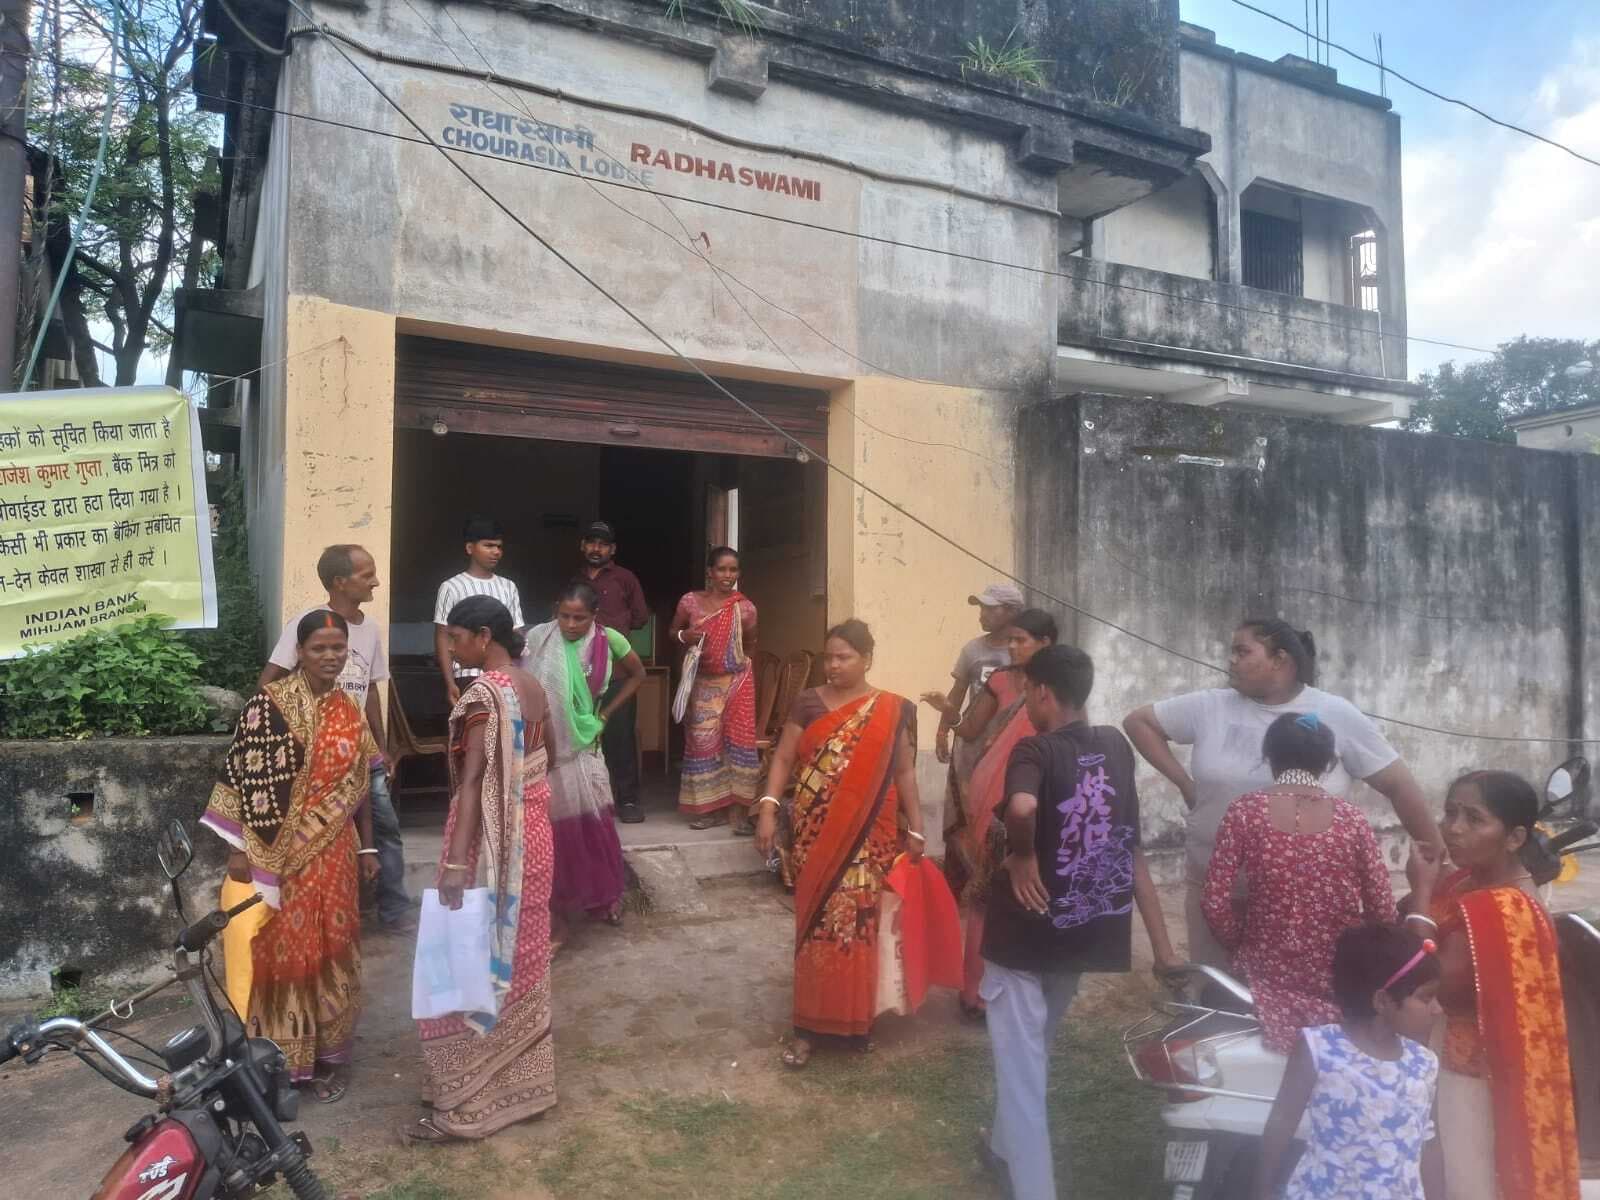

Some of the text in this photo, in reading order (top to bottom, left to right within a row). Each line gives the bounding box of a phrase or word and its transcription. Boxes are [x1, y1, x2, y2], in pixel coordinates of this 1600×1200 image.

[442, 126, 571, 169] CHOURASIA
[630, 142, 821, 201] RADHASWAMI
[27, 424, 46, 448] को
[50, 423, 87, 452] सूचित
[93, 420, 123, 442] किया
[128, 422, 157, 440] जाता
[161, 415, 170, 439] है
[35, 463, 70, 489] कुमार
[112, 452, 132, 475] बैंक
[137, 451, 159, 472] मित्र
[0, 494, 47, 522] ोवाईडर
[51, 497, 78, 517] द्वारा
[82, 494, 104, 514] हटा
[108, 487, 134, 510] दिया
[139, 488, 159, 505] गया
[33, 530, 48, 552] भी
[53, 531, 87, 550] प्रकार
[37, 564, 69, 586] केवल
[75, 561, 106, 582] शाखा
[110, 553, 119, 574] से
[123, 550, 133, 571] ही
[138, 546, 155, 568] करें
[25, 591, 138, 625] INDIAN BANK
[20, 619, 86, 639] MIHIJAM
